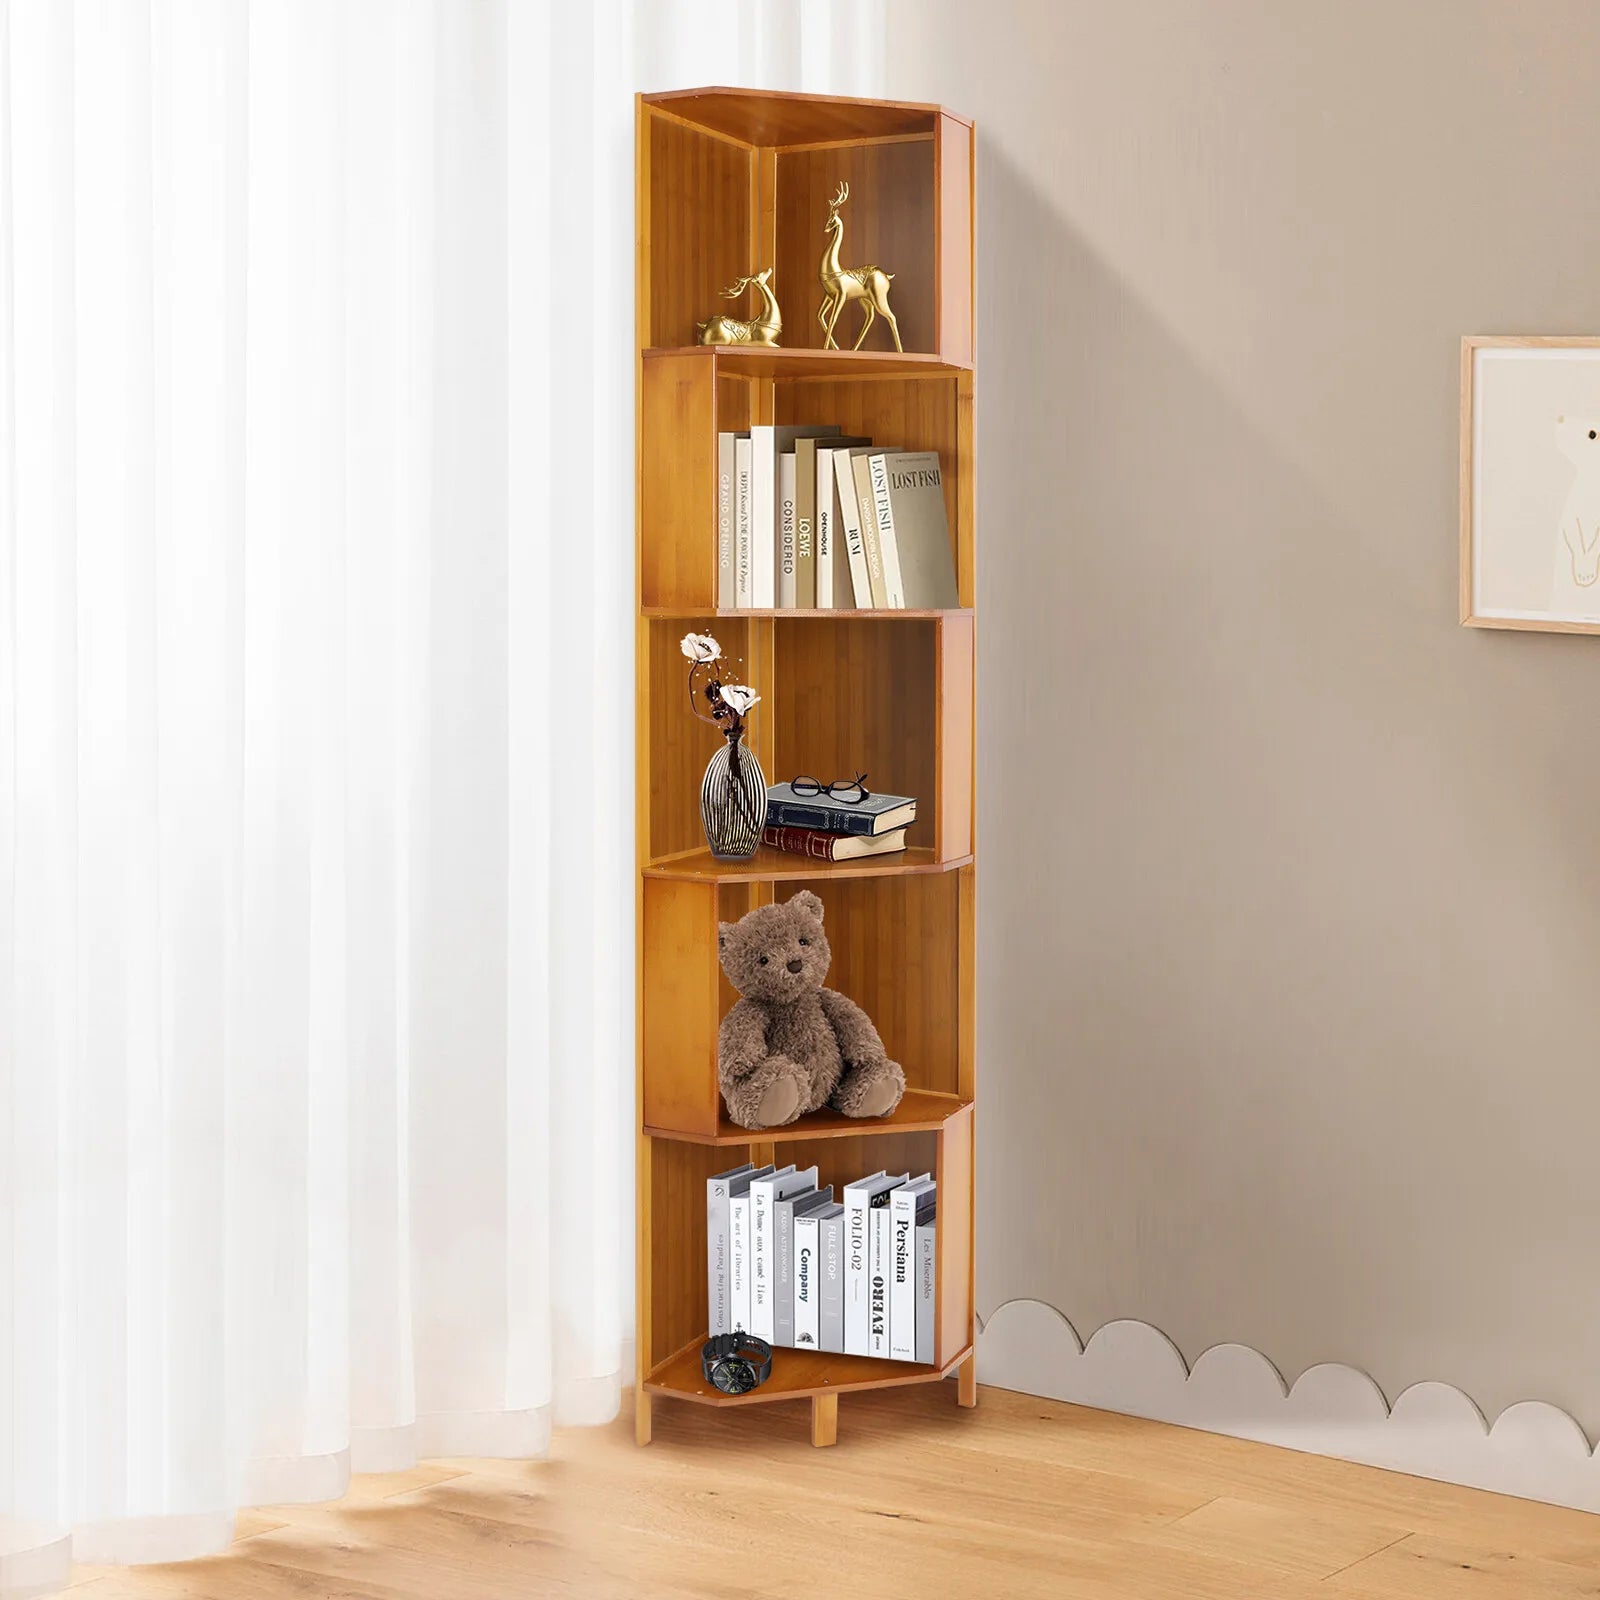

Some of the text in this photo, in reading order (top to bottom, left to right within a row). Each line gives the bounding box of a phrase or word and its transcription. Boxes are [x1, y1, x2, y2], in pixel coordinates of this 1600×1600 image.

[872, 459, 891, 531] LOST FISH
[892, 469, 940, 489] LOST FISH
[720, 474, 730, 568] GRAND OPENING
[783, 500, 793, 575] CONSIDERED
[798, 518, 810, 558] LOEWE
[848, 528, 861, 556] RUM
[756, 1193, 765, 1205] La
[757, 1210, 765, 1232] Dame
[735, 1240, 742, 1249] of
[828, 1224, 837, 1251] FULL
[851, 1208, 863, 1271] FOLIO-02
[896, 1219, 910, 1283] Persiana
[799, 1248, 811, 1303] Company
[923, 1238, 931, 1300] Les Miserables
[872, 1276, 884, 1336] EVERO
